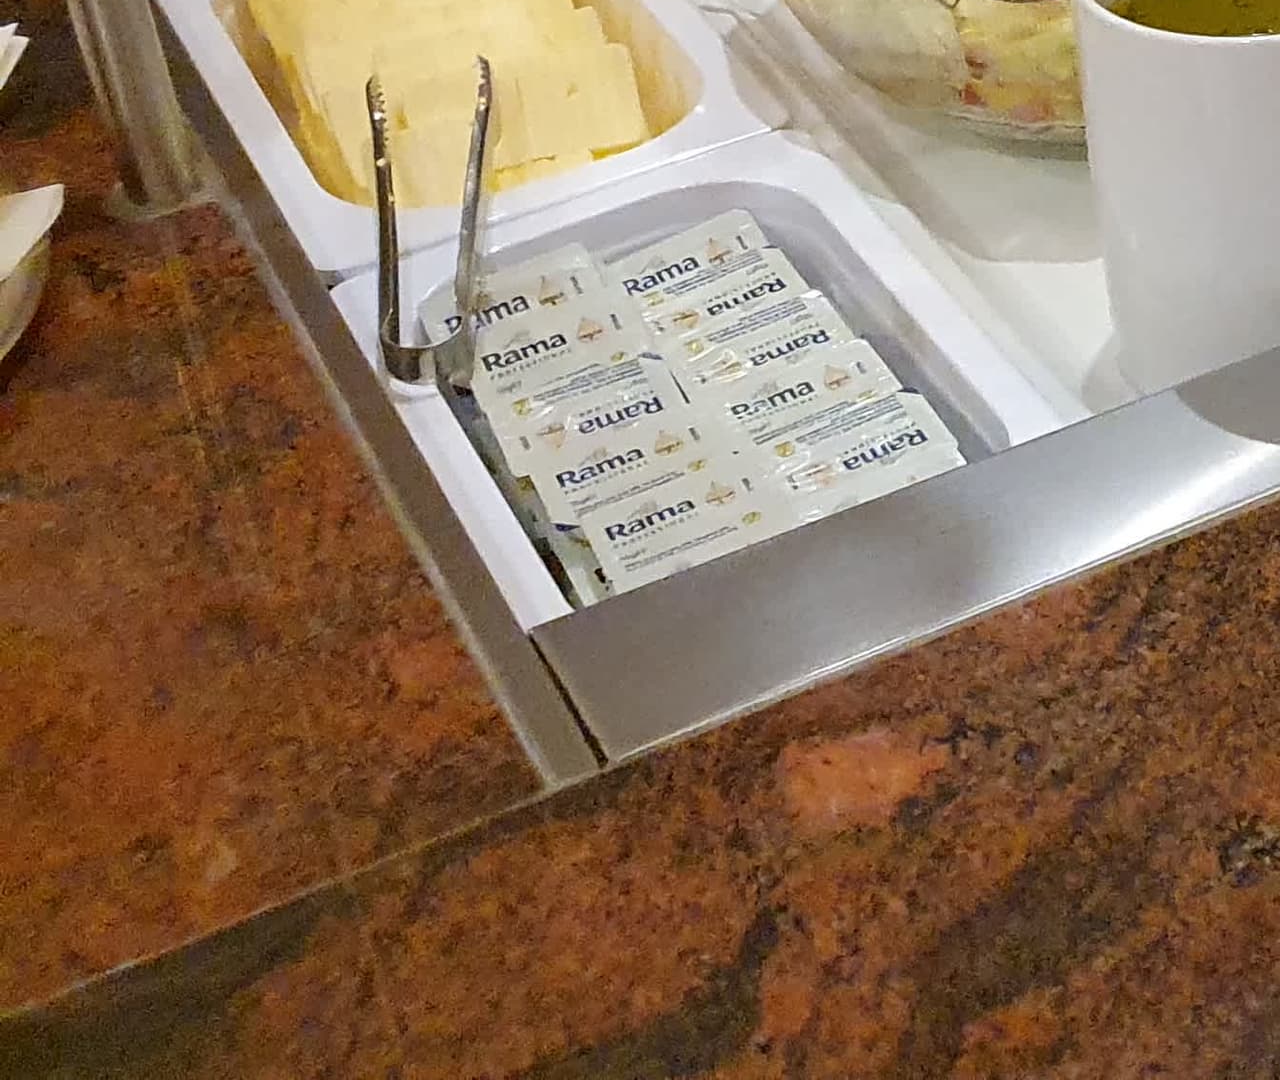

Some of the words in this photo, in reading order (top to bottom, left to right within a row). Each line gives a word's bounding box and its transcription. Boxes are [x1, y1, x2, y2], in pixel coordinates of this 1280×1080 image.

[622, 256, 701, 296] Rama
[706, 277, 787, 316] Rama
[481, 332, 568, 372] Rama
[749, 328, 831, 367] Rama
[578, 395, 665, 435] Rama
[730, 380, 815, 419] Rama
[555, 448, 645, 489] Rama
[842, 428, 929, 471] Rama
[604, 499, 697, 541] Rama
